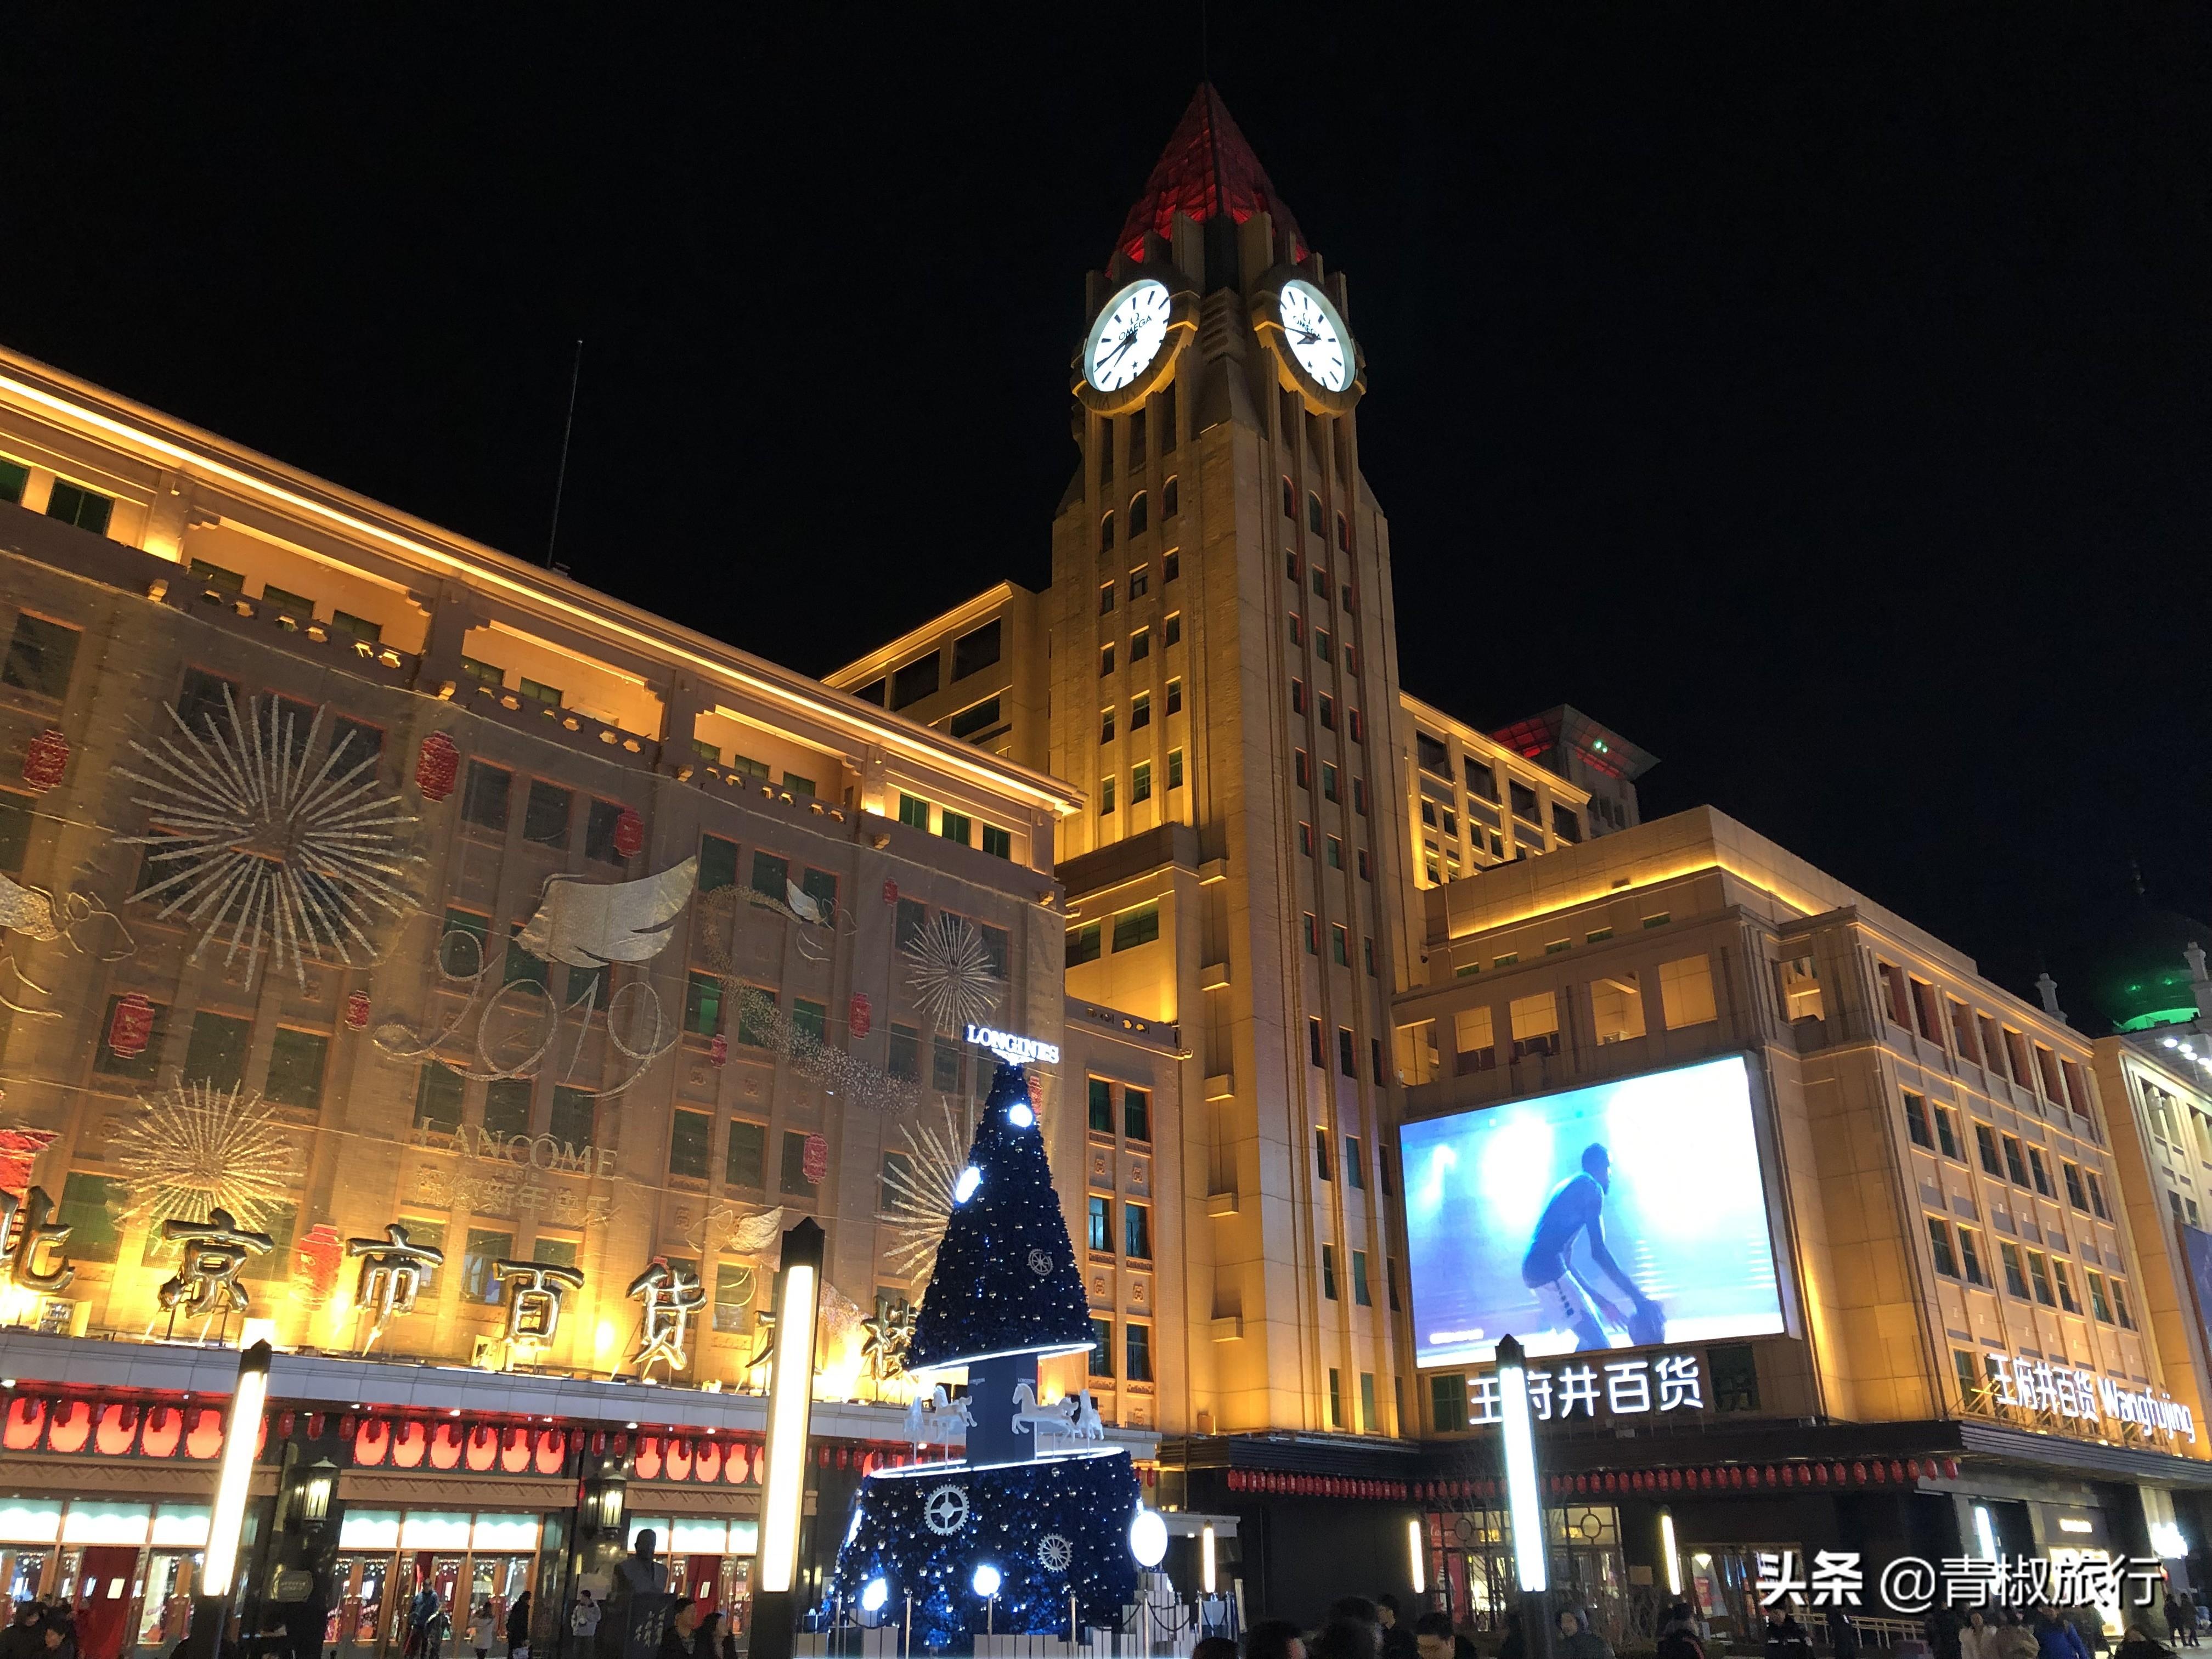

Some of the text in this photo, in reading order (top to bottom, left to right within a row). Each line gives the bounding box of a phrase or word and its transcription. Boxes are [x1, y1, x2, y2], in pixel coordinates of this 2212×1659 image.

[1119, 315, 1152, 340] OMEGA
[372, 928, 680, 1098] 2019
[967, 1024, 1059, 1064] LONGINES
[495, 1165, 539, 1181] PARIS
[1987, 1352, 2196, 1444] 王府井百货 Wangfujing
